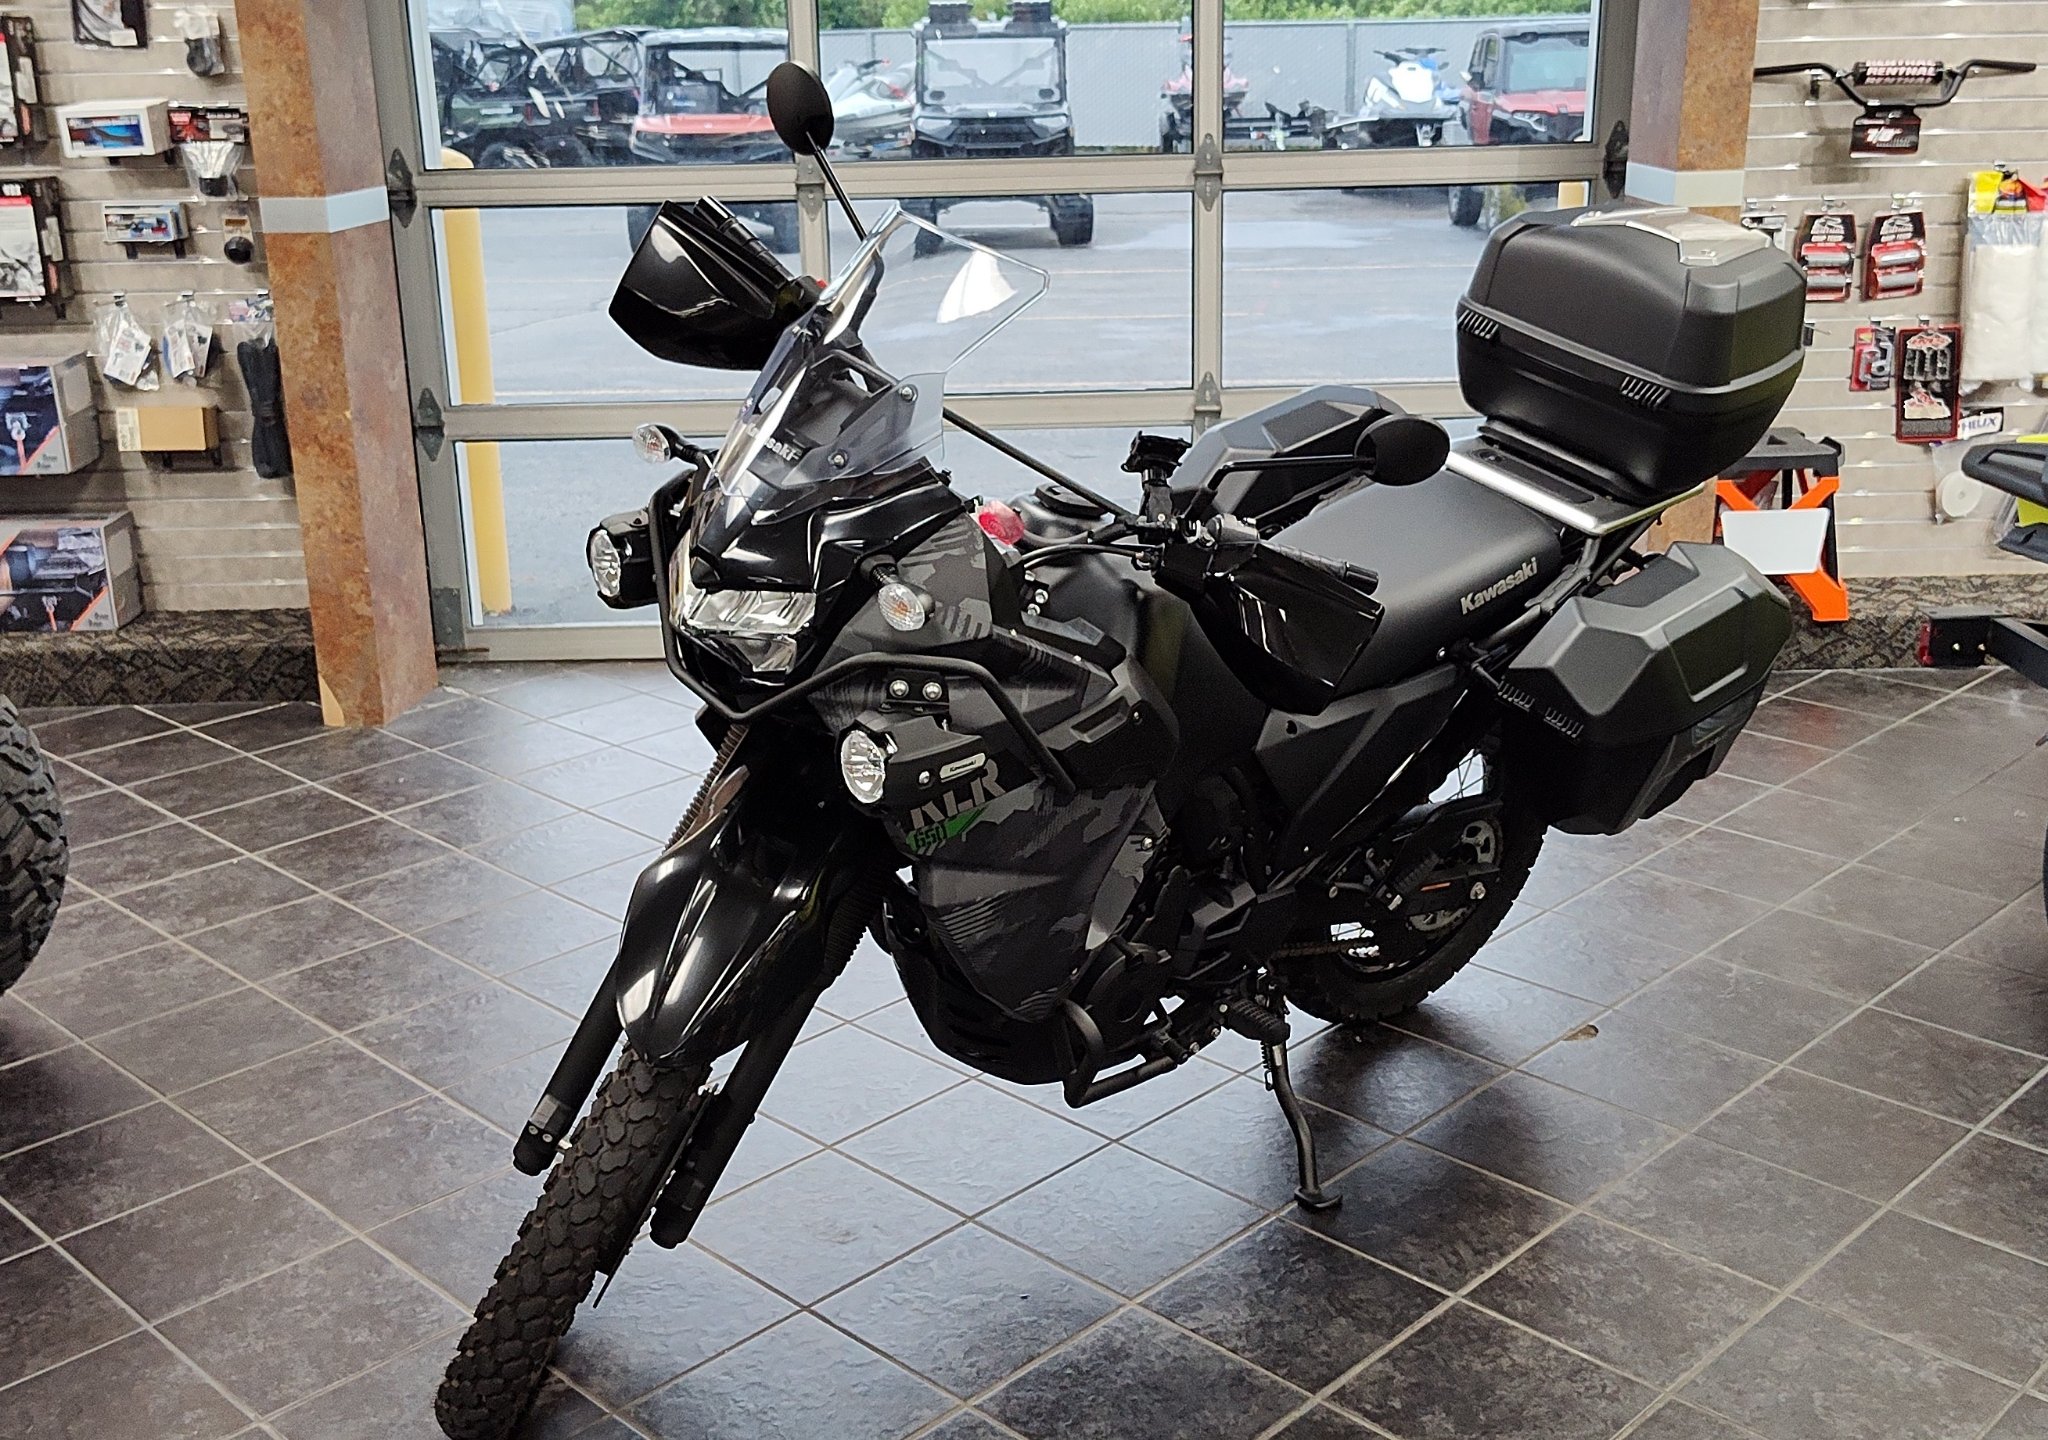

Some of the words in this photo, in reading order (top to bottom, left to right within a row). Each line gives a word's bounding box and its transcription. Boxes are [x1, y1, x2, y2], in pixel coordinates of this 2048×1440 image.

[1866, 67, 1937, 76] RENTHAL
[1460, 556, 1538, 615] Kawasaki
[913, 824, 949, 848] 650
